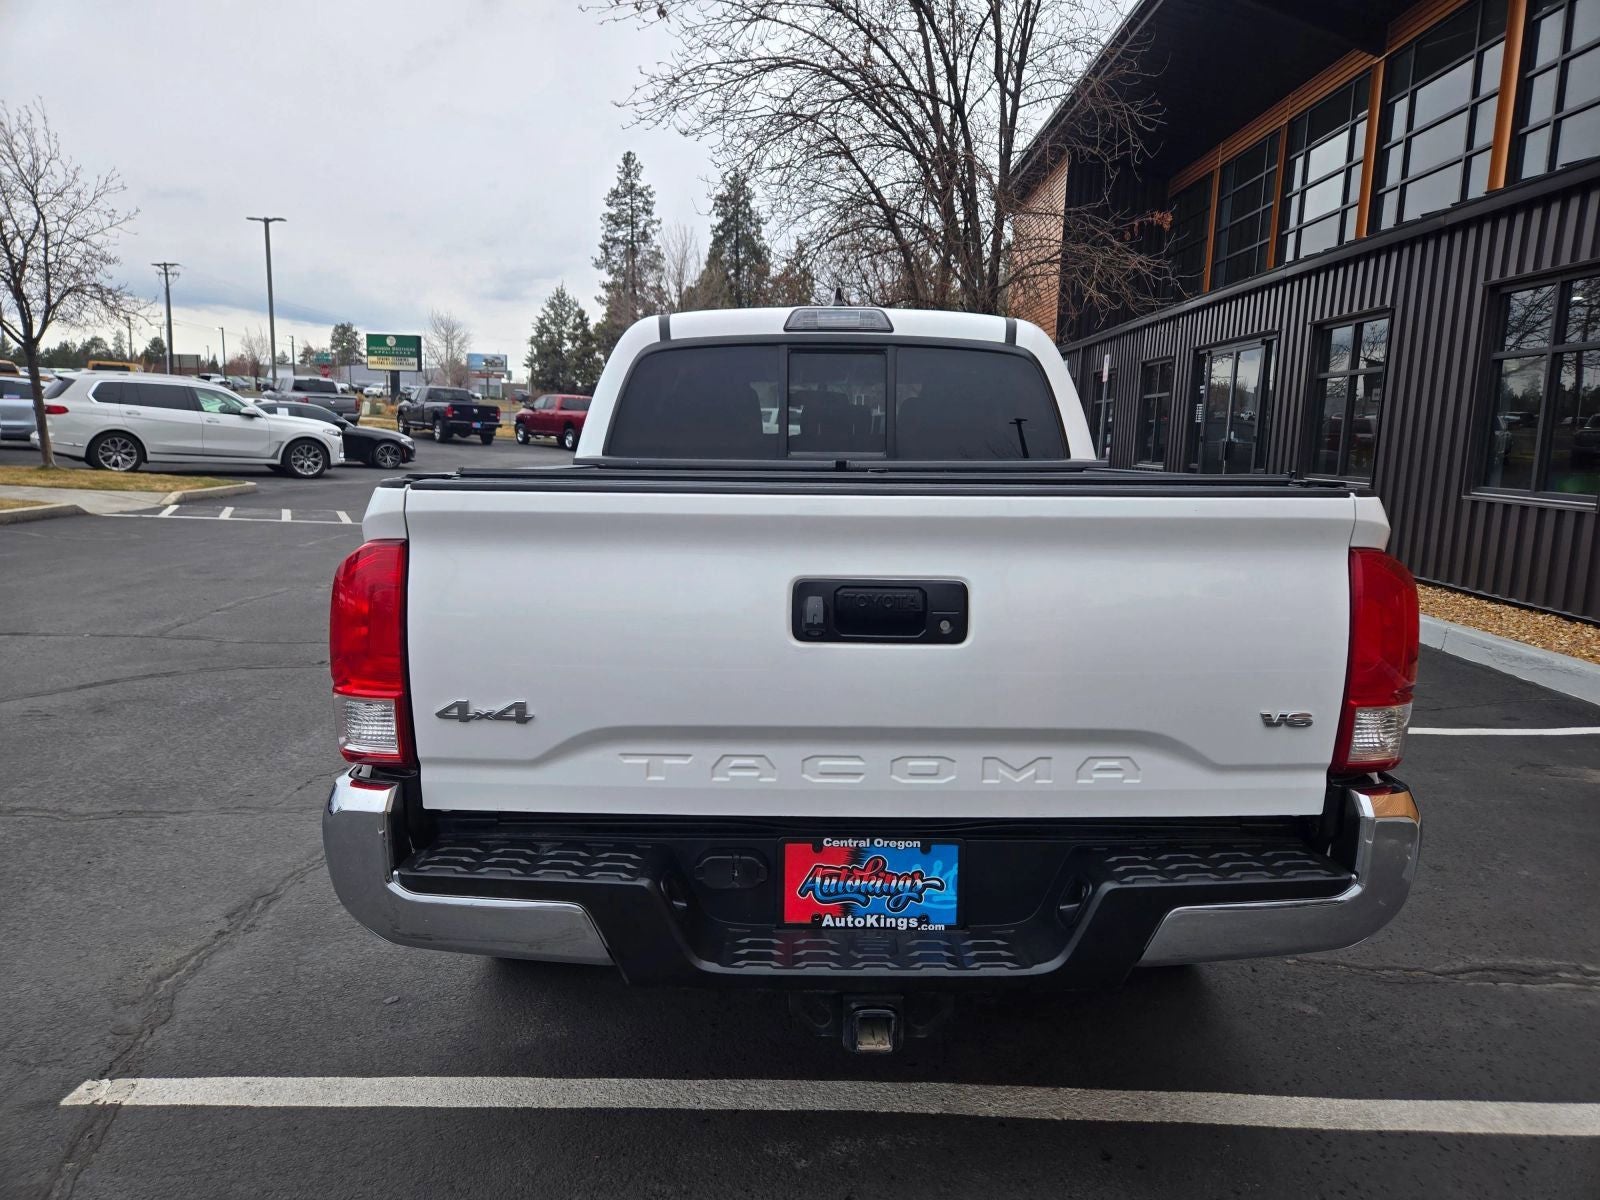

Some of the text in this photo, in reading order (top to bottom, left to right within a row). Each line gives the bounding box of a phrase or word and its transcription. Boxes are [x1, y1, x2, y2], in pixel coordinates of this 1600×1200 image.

[843, 592, 921, 611] TOYOTA
[435, 699, 535, 724] 4x4
[1260, 711, 1313, 728] V6
[618, 752, 1142, 784] TACOMA
[822, 837, 921, 850] Central Oregon
